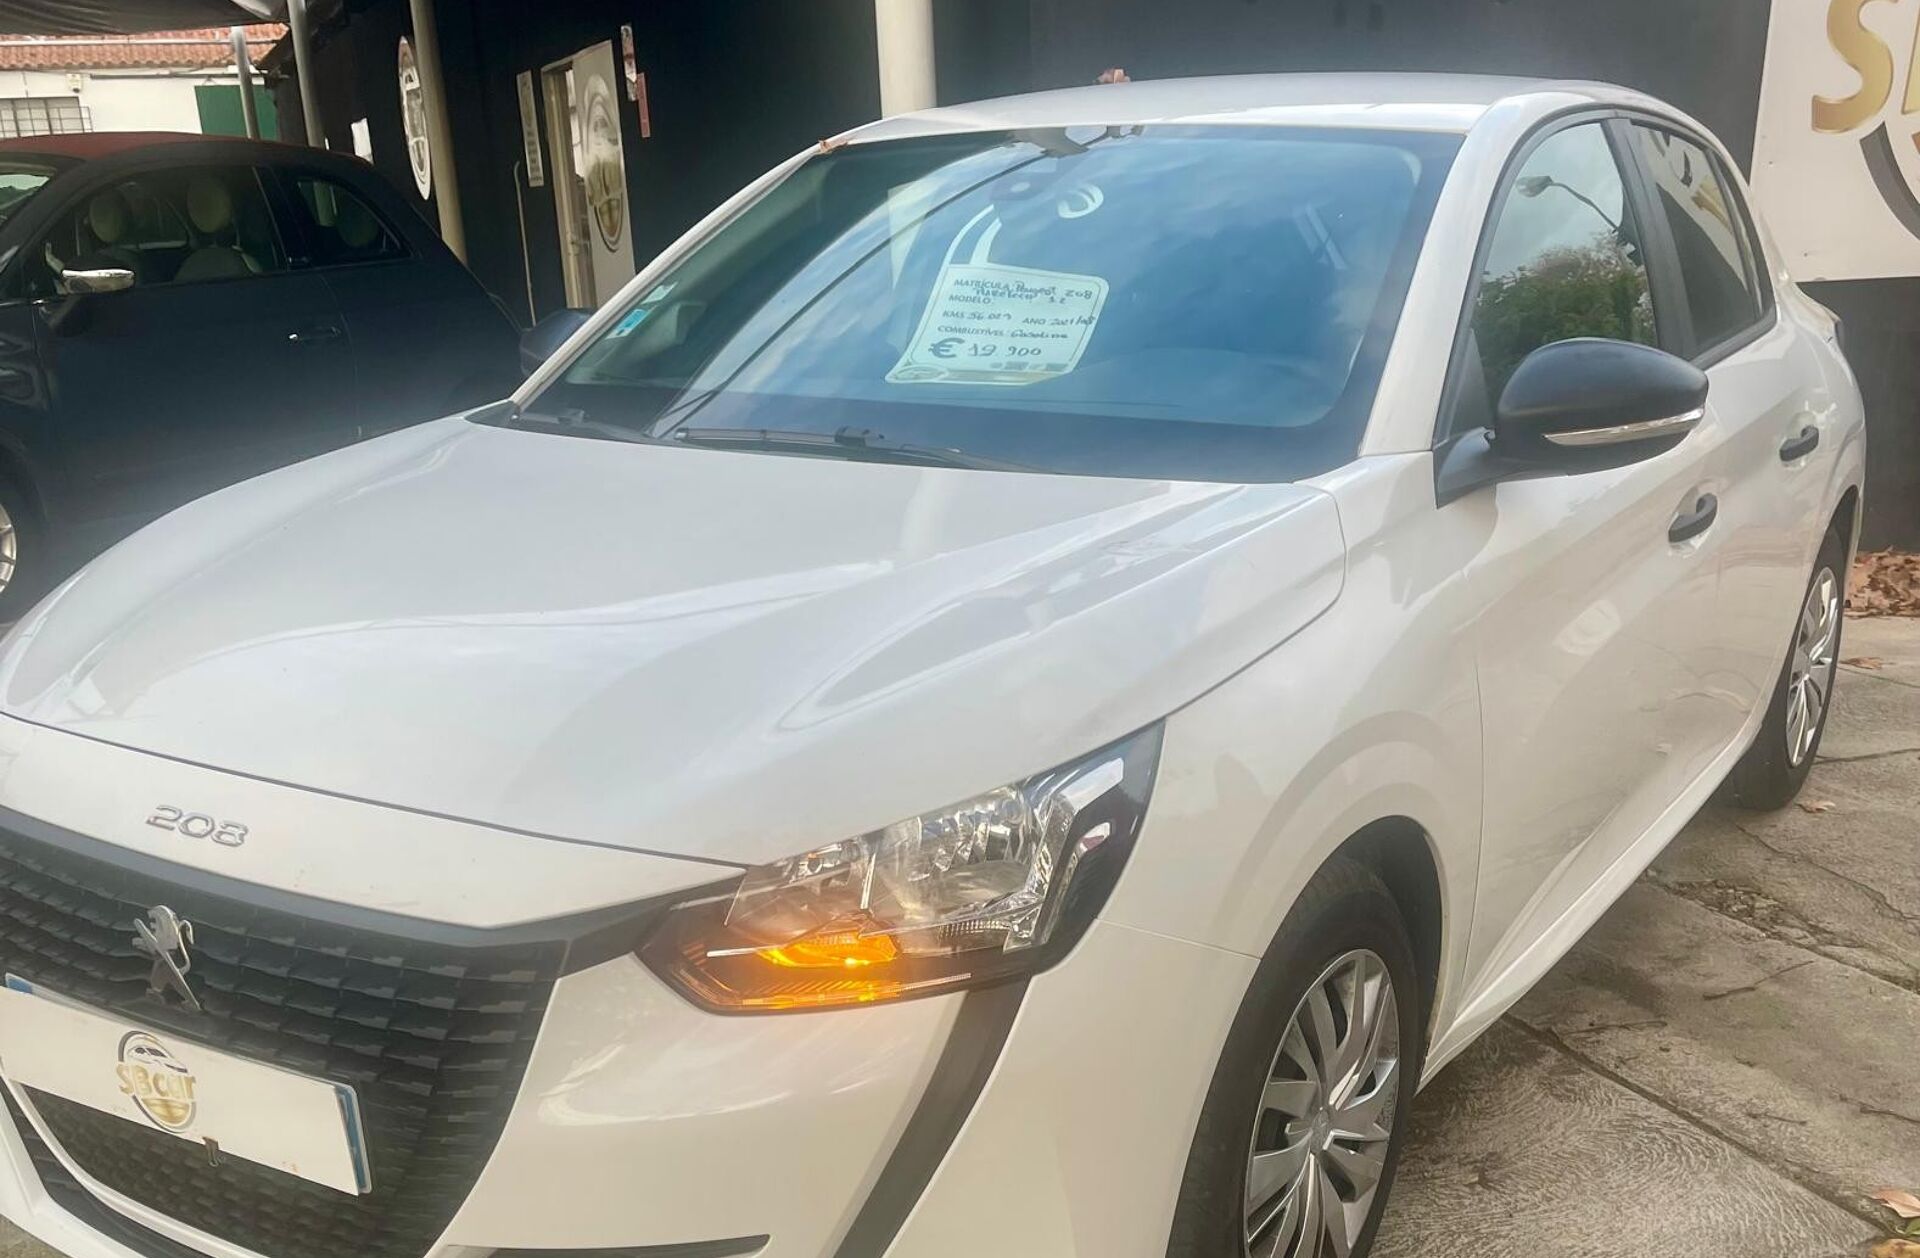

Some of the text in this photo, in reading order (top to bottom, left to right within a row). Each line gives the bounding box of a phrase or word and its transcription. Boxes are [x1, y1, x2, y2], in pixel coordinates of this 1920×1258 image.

[1022, 317, 1046, 325] ANO
[927, 337, 966, 359] €
[146, 804, 249, 848] 208
